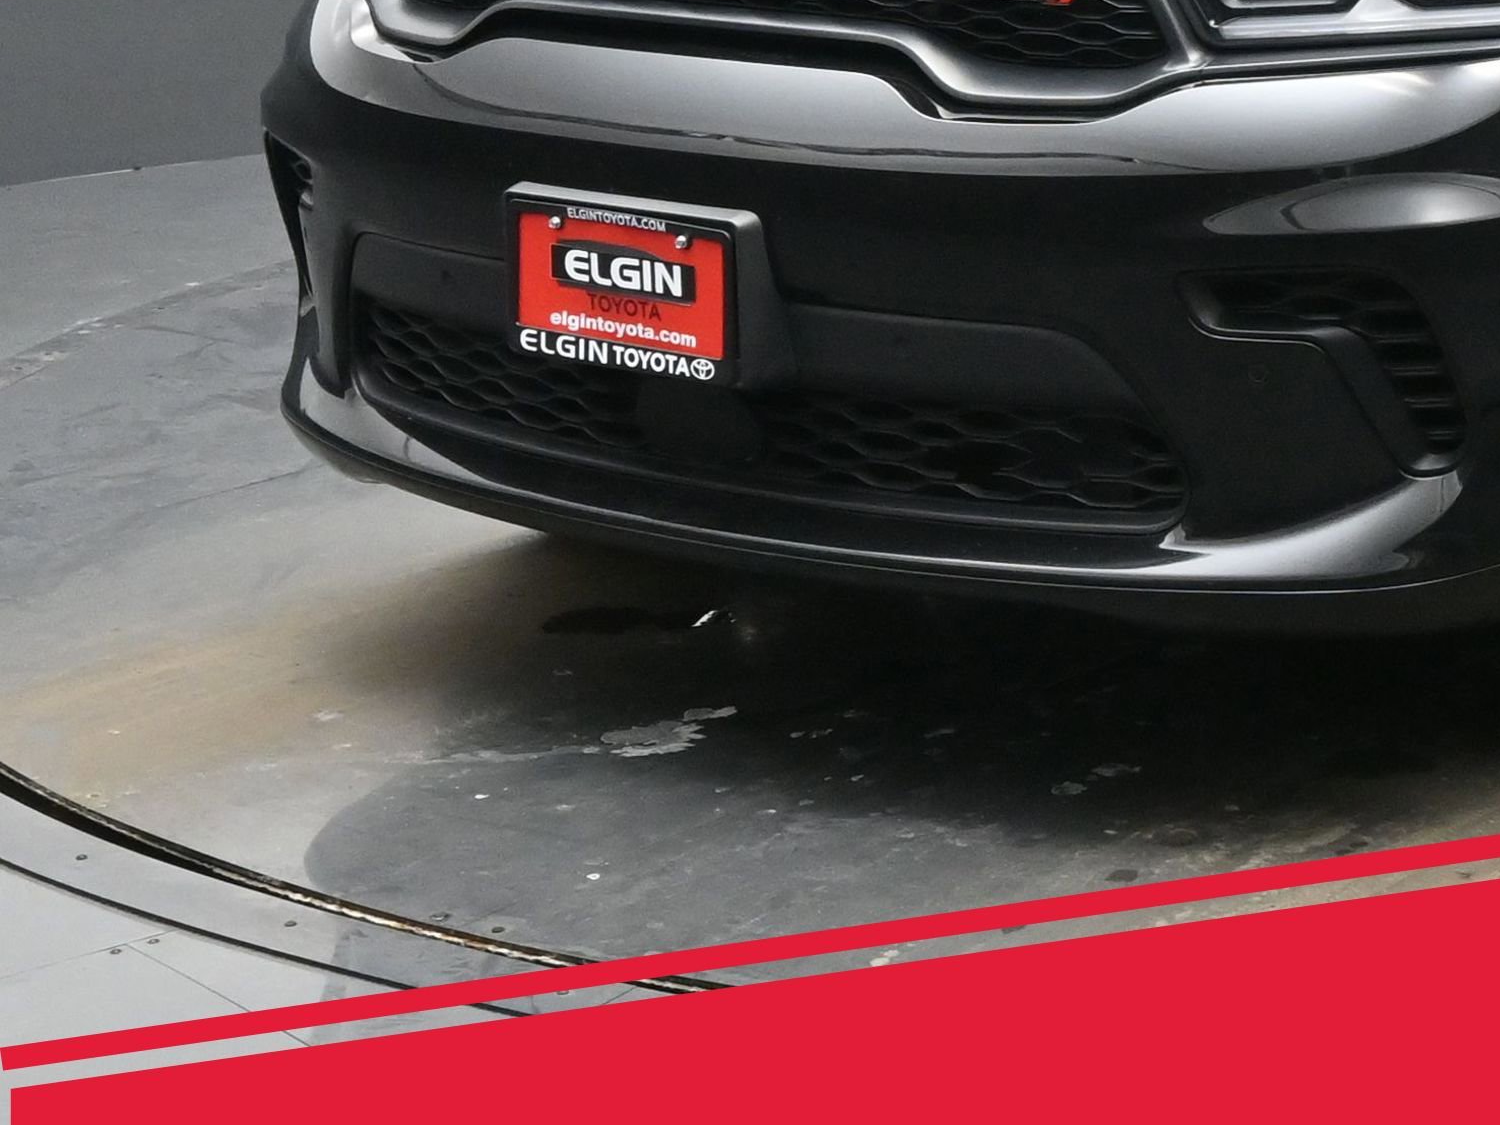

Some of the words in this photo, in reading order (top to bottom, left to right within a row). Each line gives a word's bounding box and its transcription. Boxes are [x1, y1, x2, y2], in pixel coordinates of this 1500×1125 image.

[566, 207, 666, 233] ELGINTOYOTA.COM
[564, 249, 683, 298] ELGIN
[587, 293, 662, 322] TOYOTA
[549, 310, 697, 348] elgintoyota.com
[519, 328, 609, 365] ELGIN
[612, 345, 690, 377] TOYOTA
